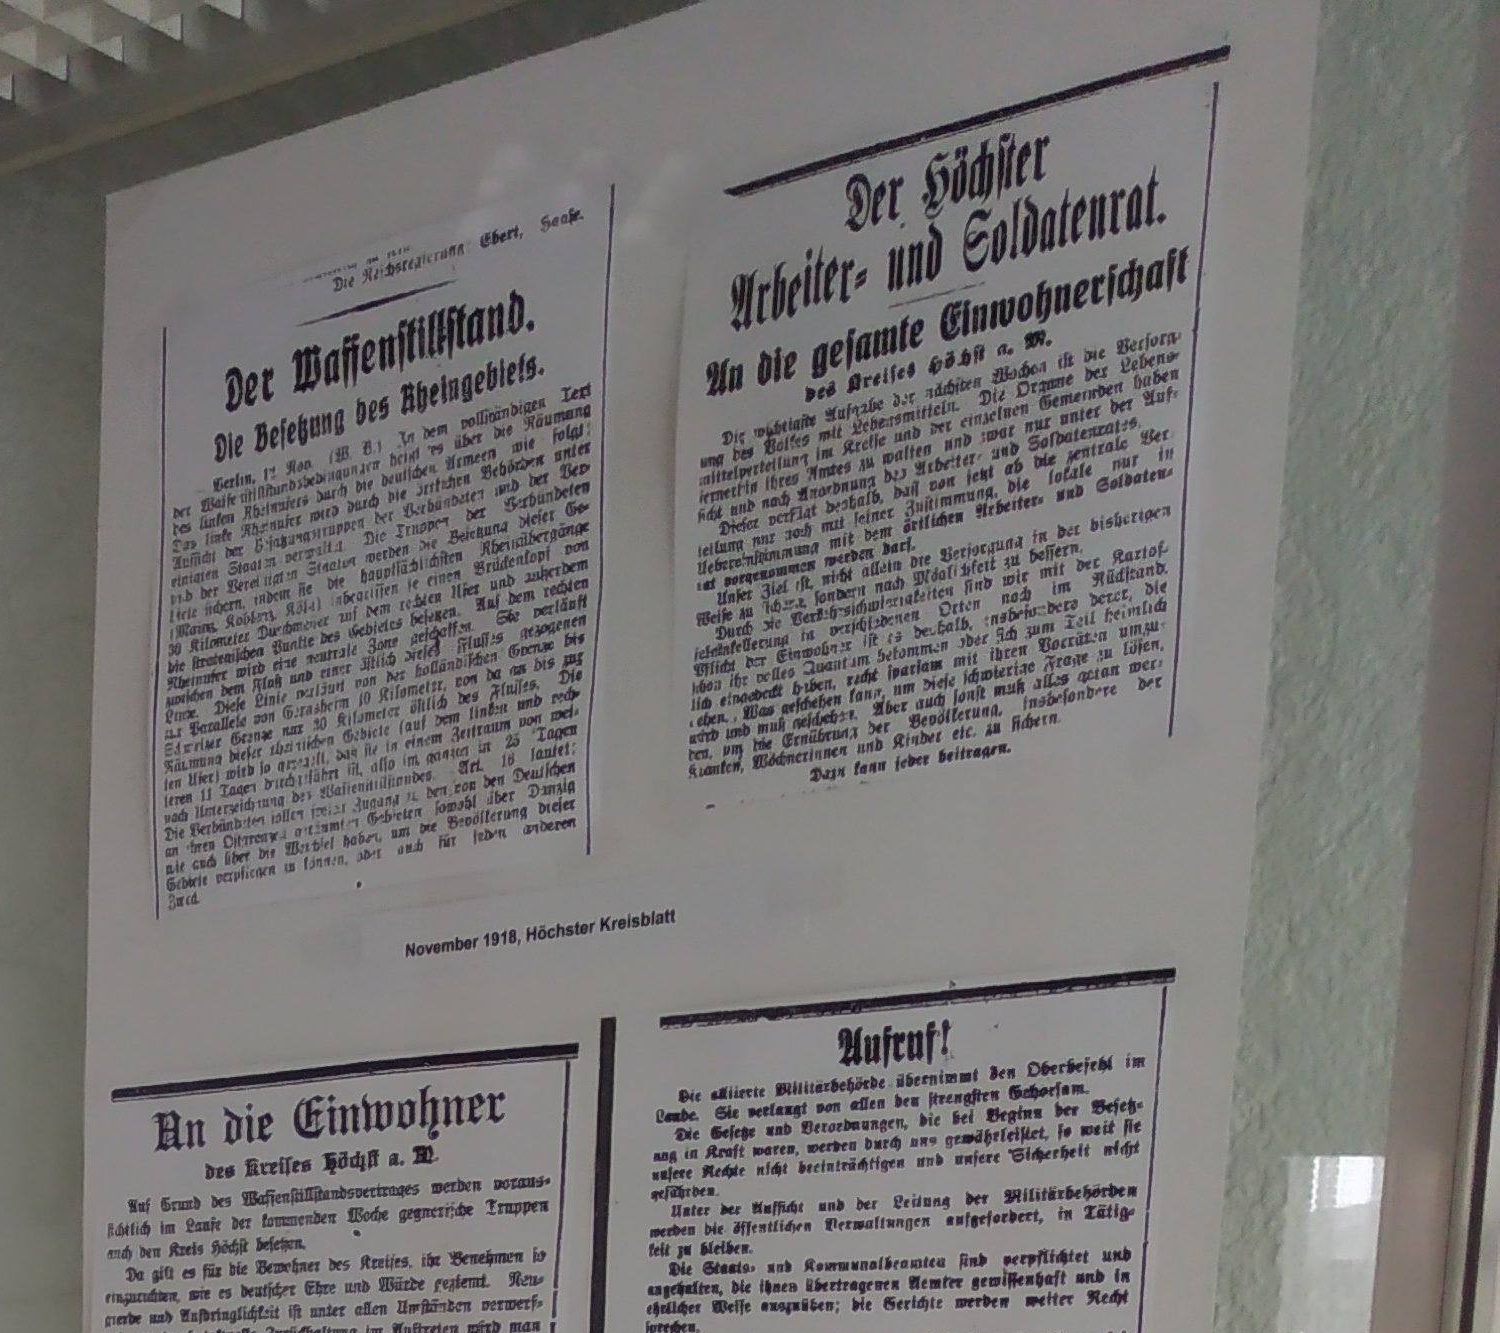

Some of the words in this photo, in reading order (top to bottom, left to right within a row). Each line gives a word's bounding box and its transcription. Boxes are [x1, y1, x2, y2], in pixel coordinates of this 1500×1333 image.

[844, 172, 905, 233] Der
[921, 132, 1050, 218] Höchster
[887, 221, 943, 293] und
[962, 164, 1167, 273] Soldatenrat.
[705, 357, 744, 397] An
[757, 346, 798, 386] die
[811, 314, 925, 379] gesamte
[939, 244, 1190, 342] Einwohnerschaft
[224, 366, 274, 413] Der
[213, 431, 244, 463] Die
[355, 395, 389, 426] des
[405, 936, 479, 958] November
[483, 928, 521, 946] 1918,
[526, 919, 596, 943] Höchster
[599, 908, 676, 932] Kreisblatt
[838, 1019, 952, 1069] Aufruf!
[151, 1109, 206, 1152] An
[222, 1102, 274, 1146] die
[293, 1084, 506, 1141] Einwohner
[204, 1162, 236, 1180] des
[388, 1152, 405, 1167] a.
